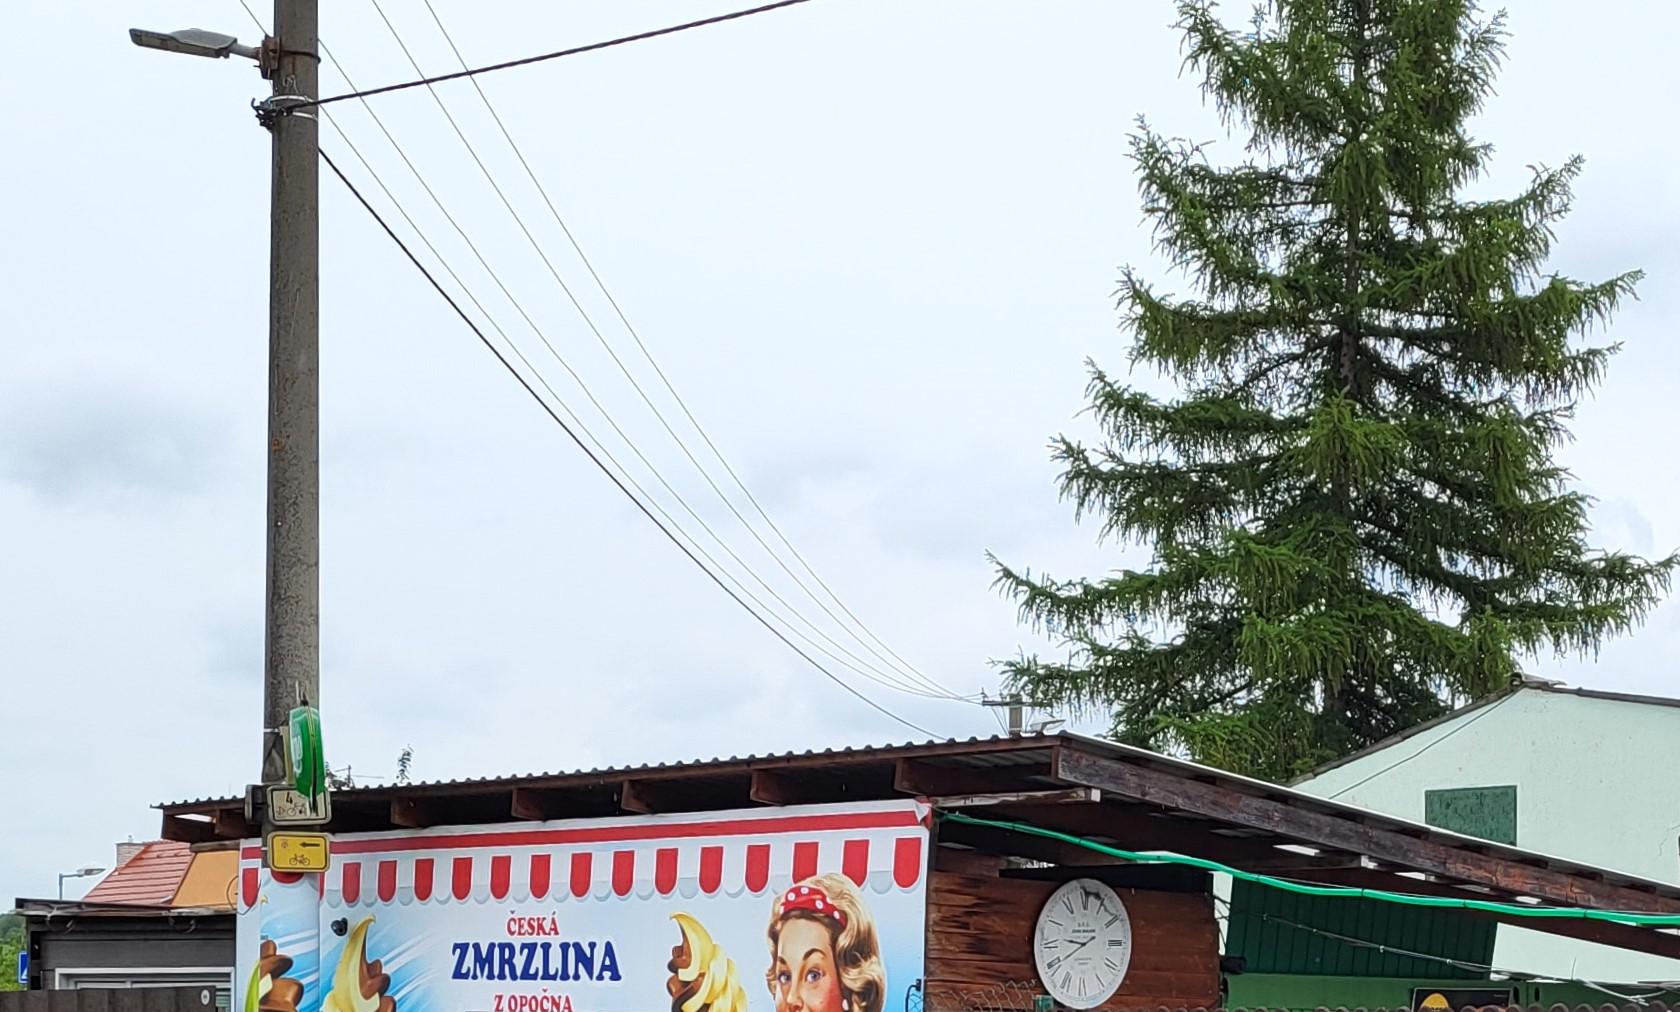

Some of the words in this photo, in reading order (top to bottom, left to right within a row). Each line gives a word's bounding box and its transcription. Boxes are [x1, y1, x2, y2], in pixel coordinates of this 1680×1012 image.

[285, 792, 294, 804] 4
[506, 910, 560, 936] ČESKÁ
[452, 941, 622, 981] ZMRZLINA
[494, 995, 504, 1012] Z
[508, 988, 573, 1012] OPOČNA
